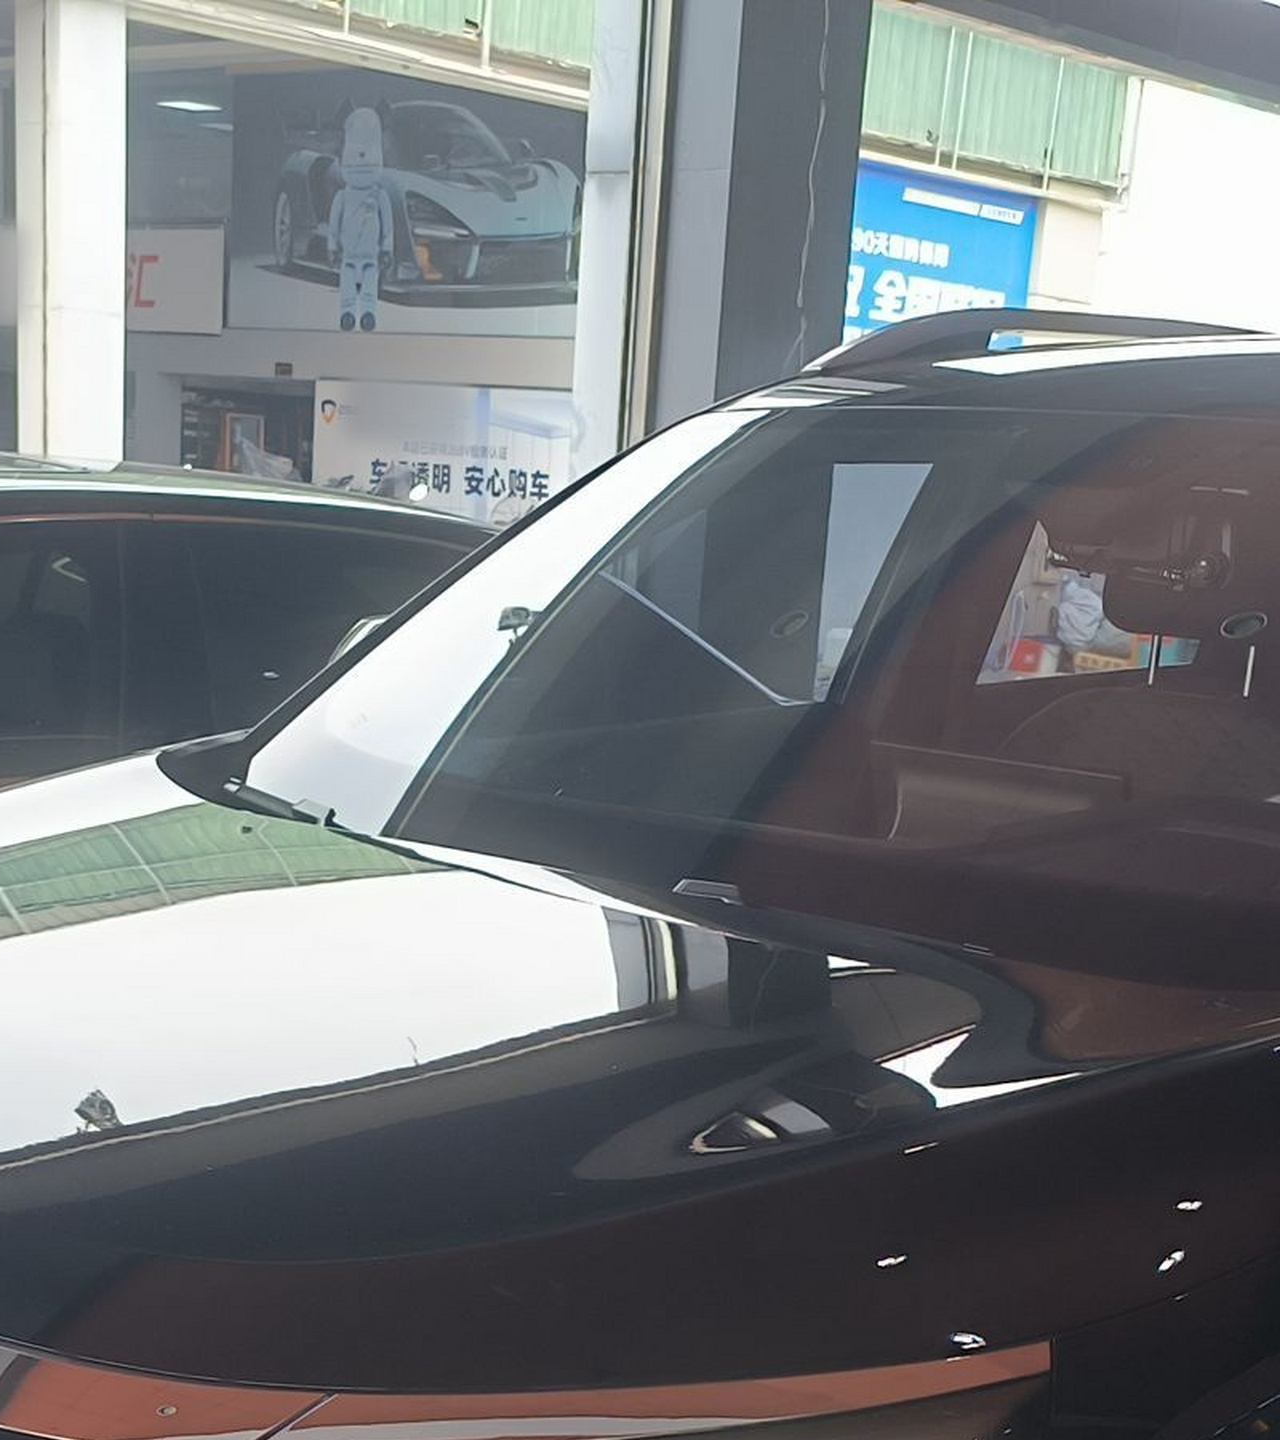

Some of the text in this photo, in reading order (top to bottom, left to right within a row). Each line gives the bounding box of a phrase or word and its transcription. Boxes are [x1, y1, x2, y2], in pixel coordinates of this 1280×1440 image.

[371, 458, 550, 501] 车透明 安心购车
